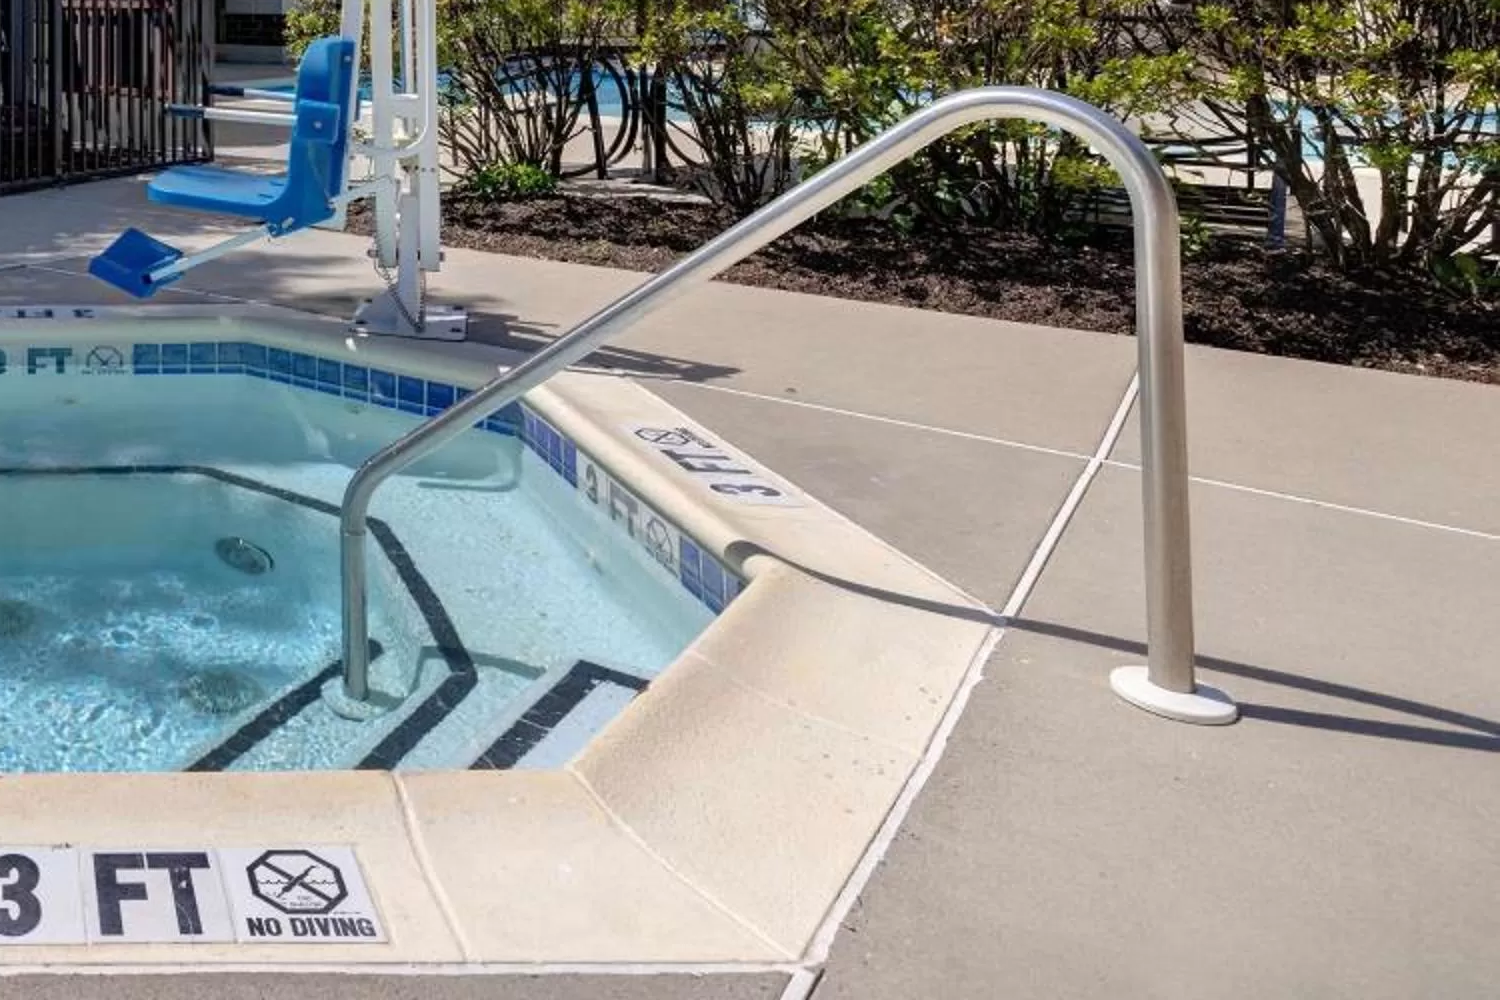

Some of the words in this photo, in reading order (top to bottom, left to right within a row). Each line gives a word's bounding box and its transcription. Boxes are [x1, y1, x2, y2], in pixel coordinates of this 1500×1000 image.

[27, 347, 73, 375] FT
[659, 449, 752, 474] FT
[586, 464, 598, 504] 3
[609, 480, 638, 537] FT
[709, 483, 781, 496] 3
[92, 852, 211, 936] FT
[246, 917, 282, 937] NO
[289, 917, 377, 937] DIVING
